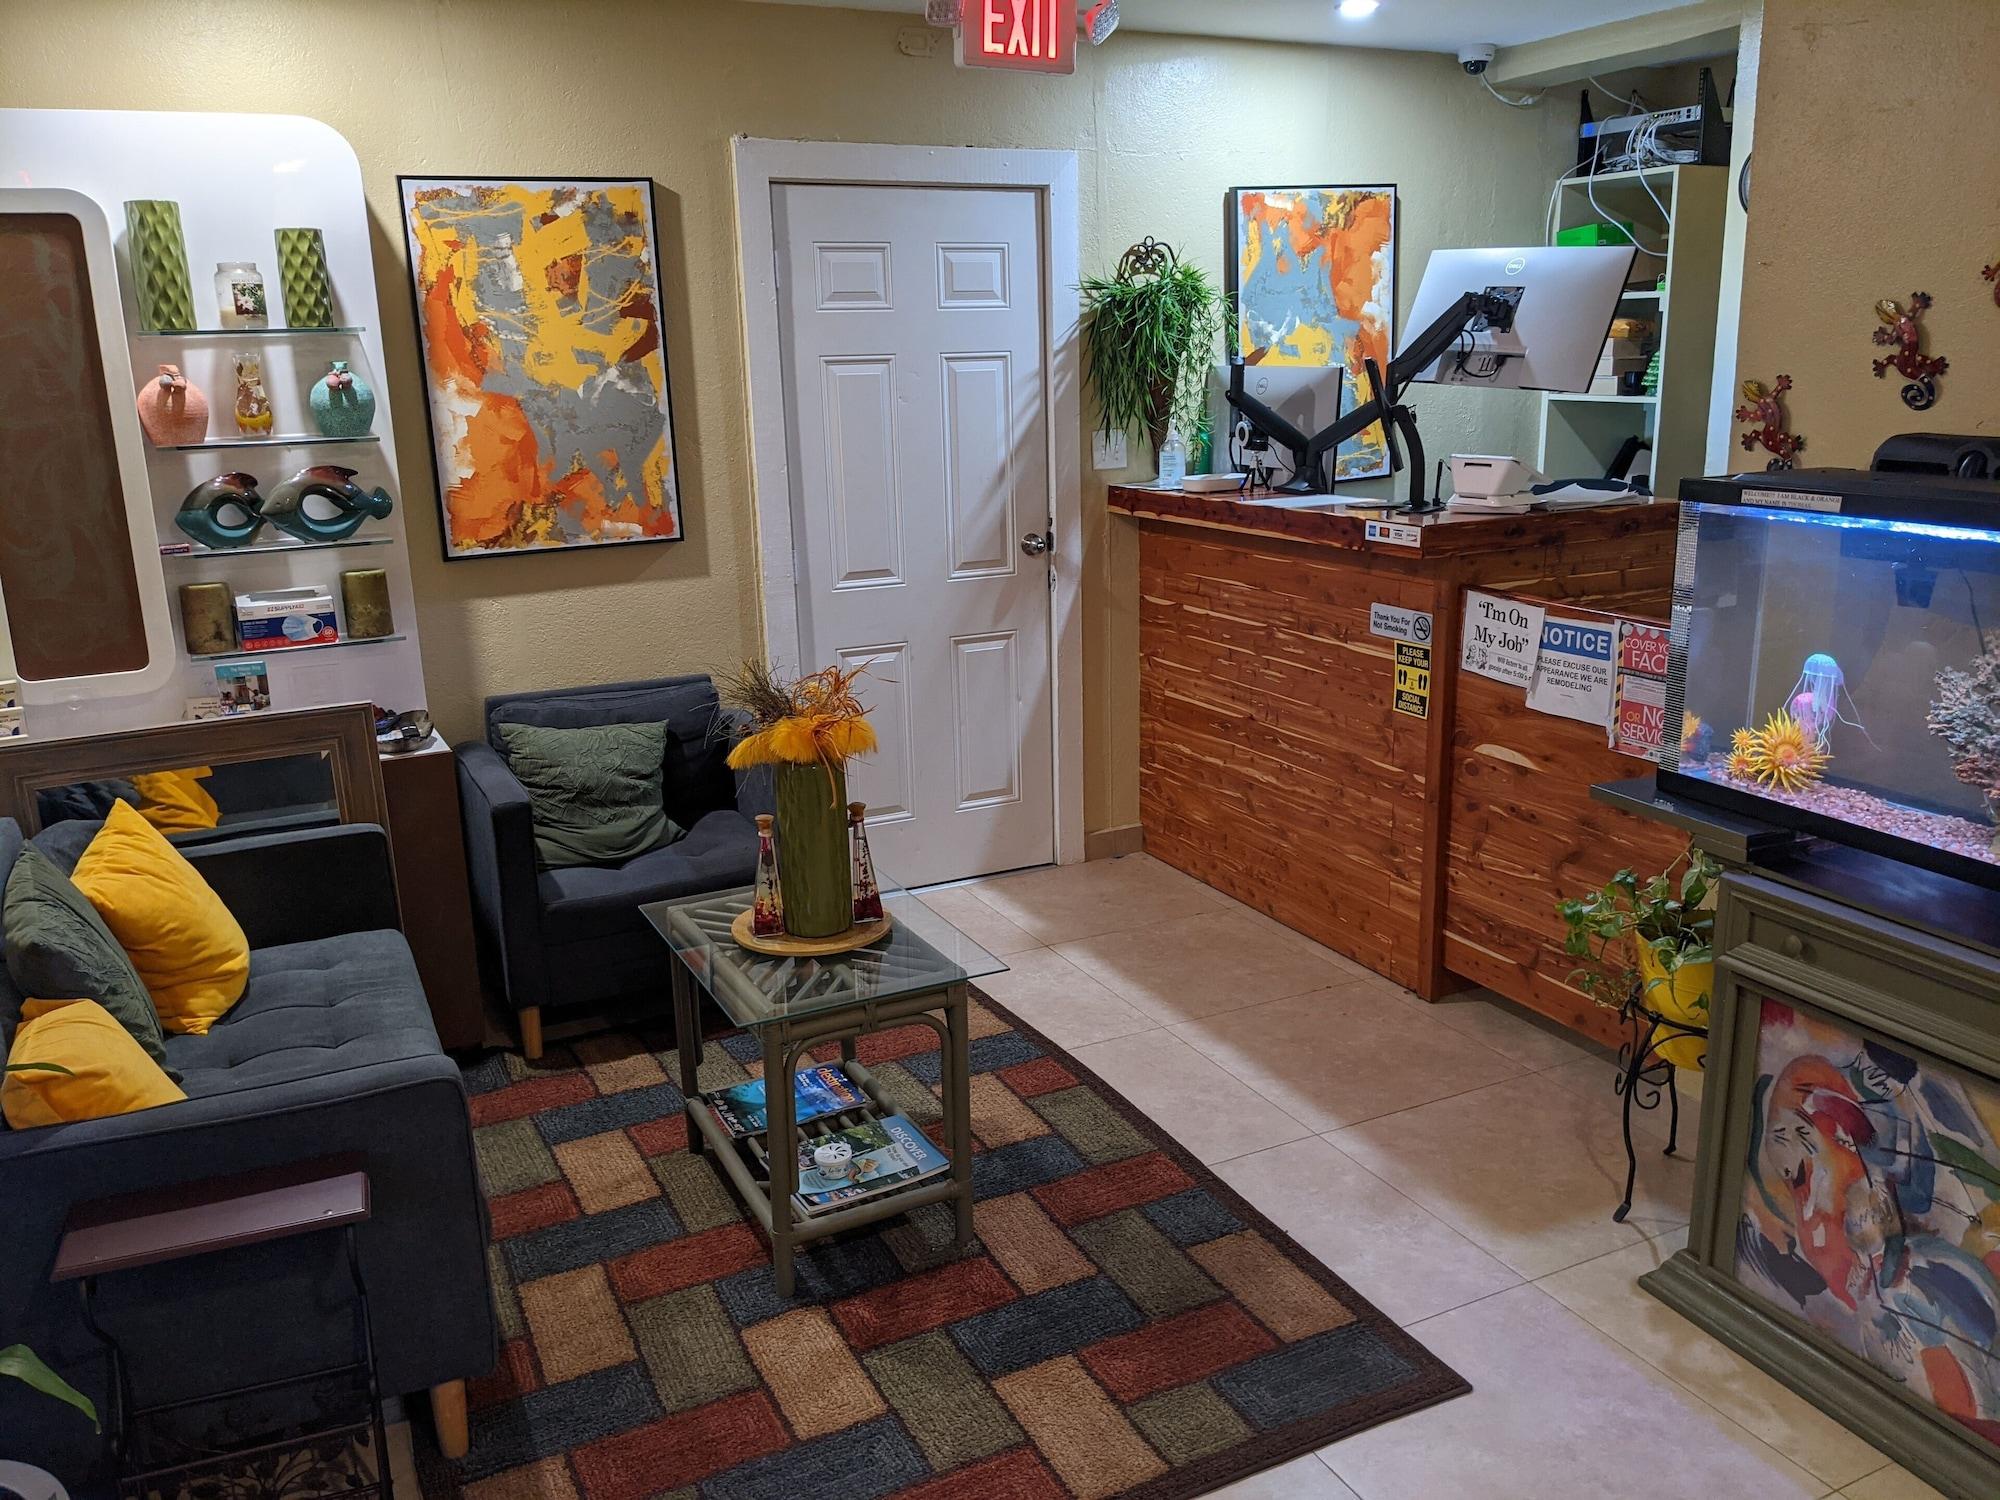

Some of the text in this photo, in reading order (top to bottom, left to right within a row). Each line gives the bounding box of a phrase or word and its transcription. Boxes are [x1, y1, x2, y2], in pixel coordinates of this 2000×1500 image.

[1791, 493, 1809, 501] BLACK
[1816, 495, 1840, 503] ORANGE
[1374, 611, 1411, 626] Thank You For
[1509, 608, 1528, 629] On
[1373, 620, 1408, 636] Not Smoking
[1473, 624, 1497, 649] My
[1541, 626, 1609, 654] NOTICE
[1624, 637, 1669, 655] COVER YO
[1402, 646, 1424, 658] PLEASE
[1398, 654, 1429, 668] KEEP YOUR
[1537, 655, 1562, 667] PLEASE
[1562, 660, 1591, 672] EXCUSE
[1591, 666, 1607, 676] OUR
[1536, 664, 1608, 686] APPEARANCE WE ARE
[1546, 677, 1592, 693] REMODELING
[1402, 692, 1421, 705] SOCIAL
[1398, 700, 1424, 715] DISTANCE
[1626, 711, 1640, 724] OR
[1621, 721, 1664, 745] SERVIC
[816, 1067, 856, 1102] destination
[890, 1126, 928, 1161] DISCOVER
